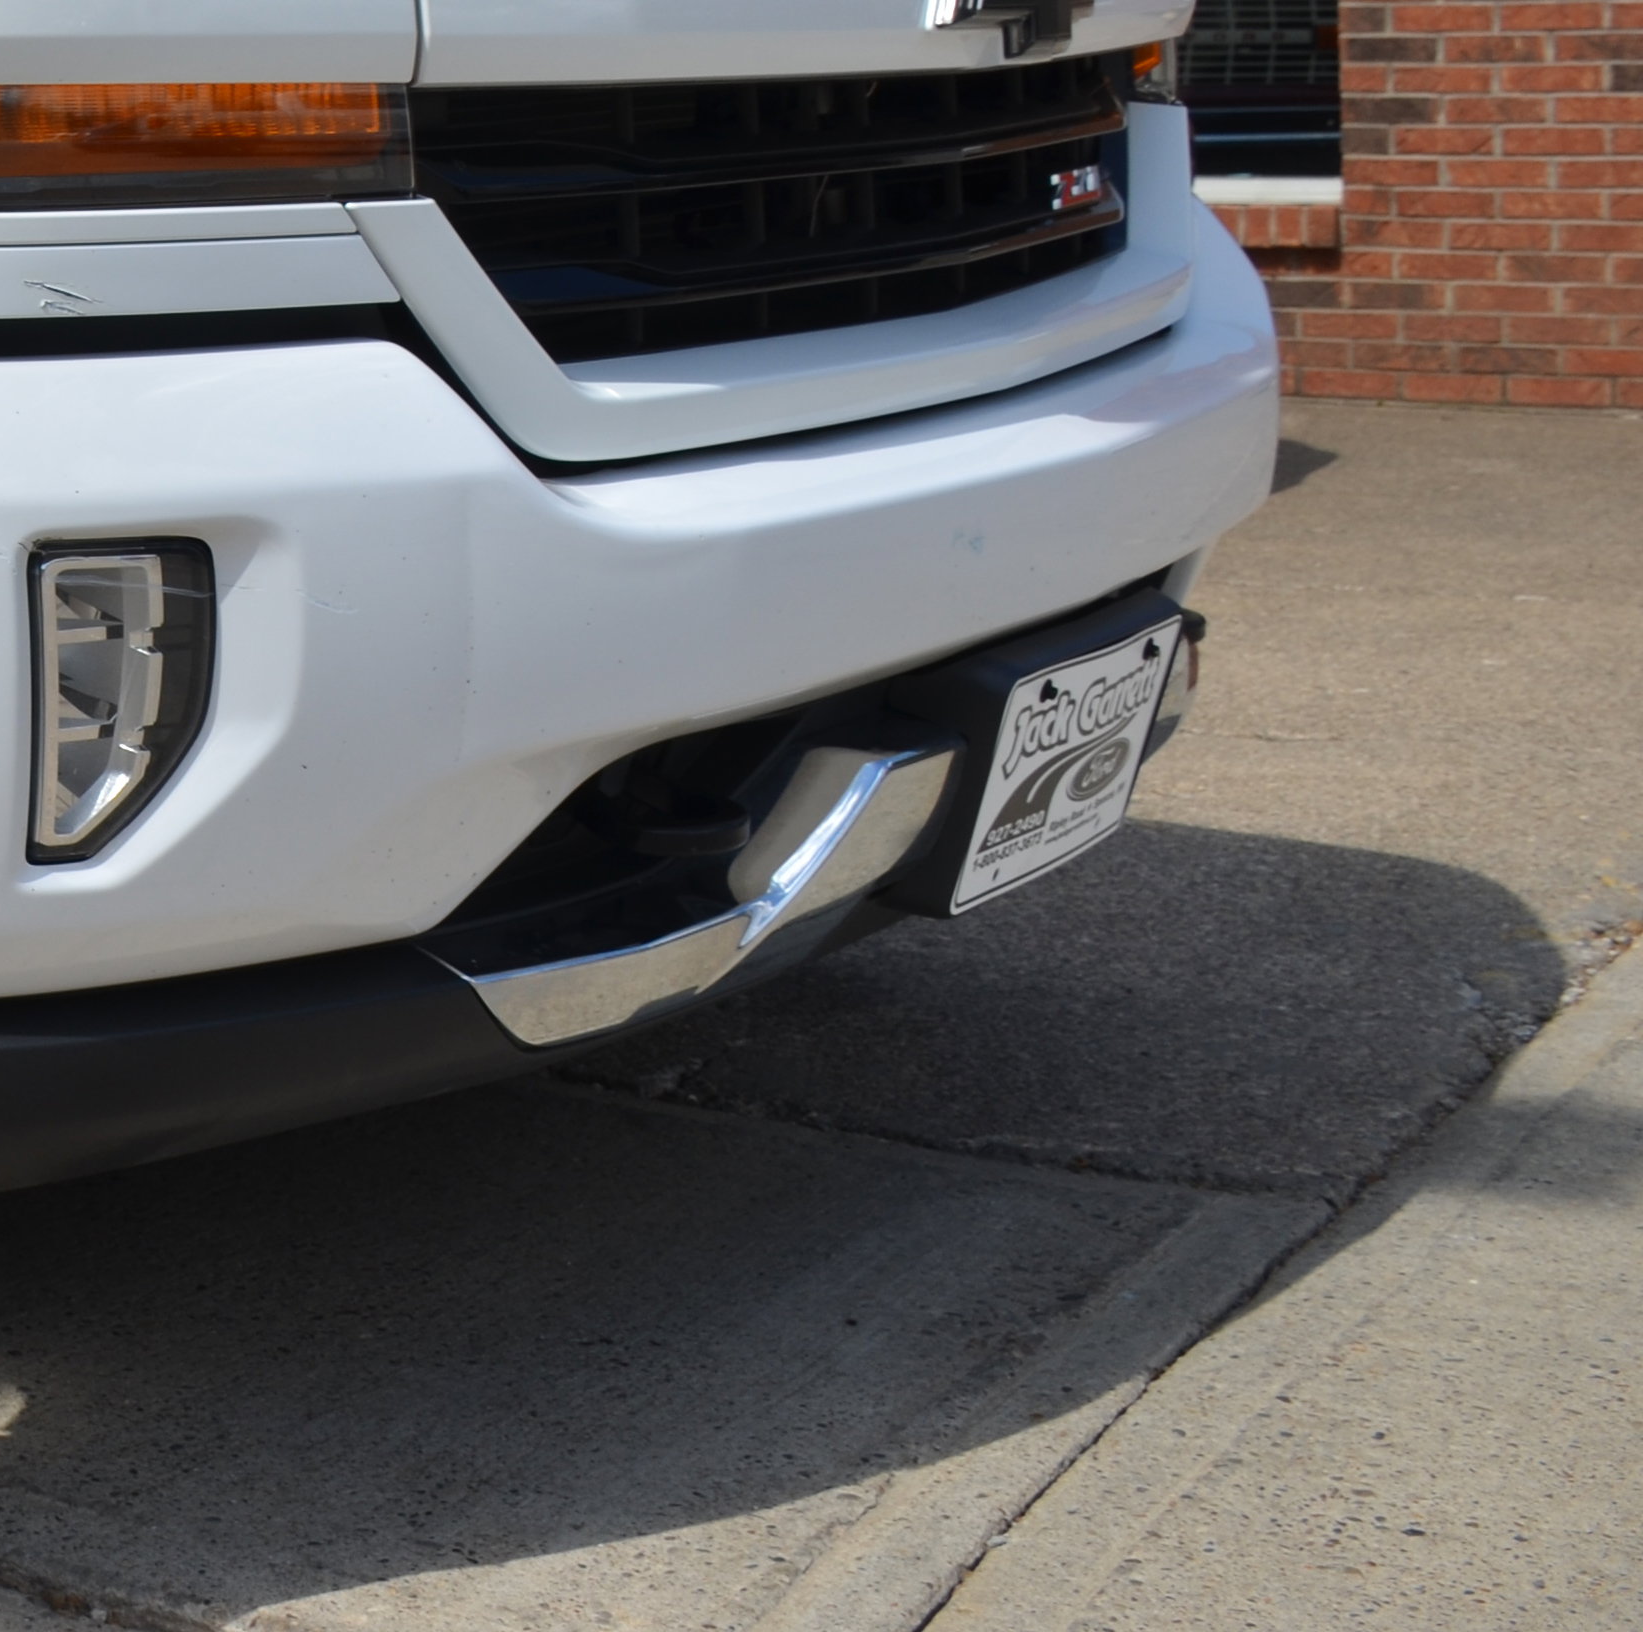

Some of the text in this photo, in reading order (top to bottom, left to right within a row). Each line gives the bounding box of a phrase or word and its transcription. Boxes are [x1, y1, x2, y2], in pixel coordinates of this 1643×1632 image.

[1001, 657, 1160, 780] Jack Garrett
[1080, 743, 1122, 789] Ford
[986, 810, 1046, 847] 927-2490
